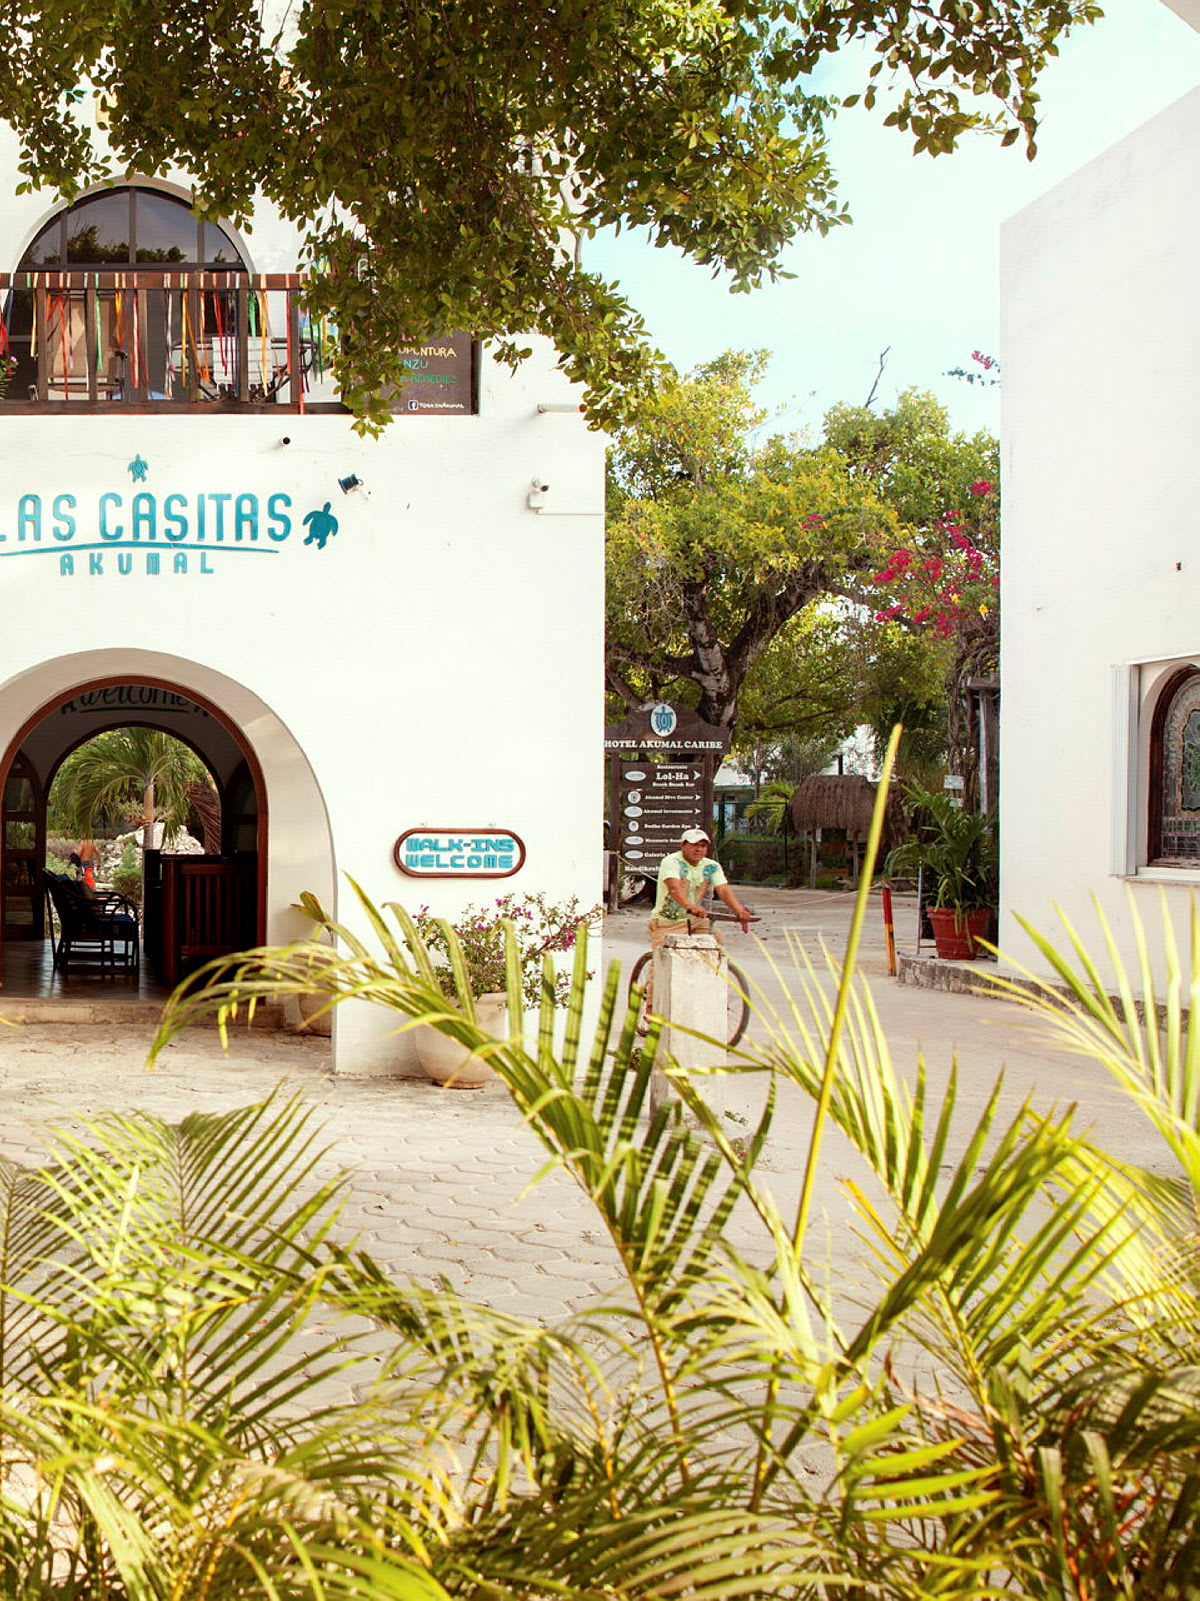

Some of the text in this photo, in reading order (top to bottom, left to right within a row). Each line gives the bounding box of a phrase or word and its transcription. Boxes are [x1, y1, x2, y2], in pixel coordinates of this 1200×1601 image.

[382, 345, 457, 358] AUPUNTURA
[99, 493, 292, 542] CASITAS
[60, 551, 215, 576] AKUMAL
[604, 740, 723, 749] HOTEL AKUMAL CARIBE
[656, 772, 689, 780] Lol-Ha
[405, 838, 515, 852] WALK-INS
[405, 854, 513, 868] WELCOME
